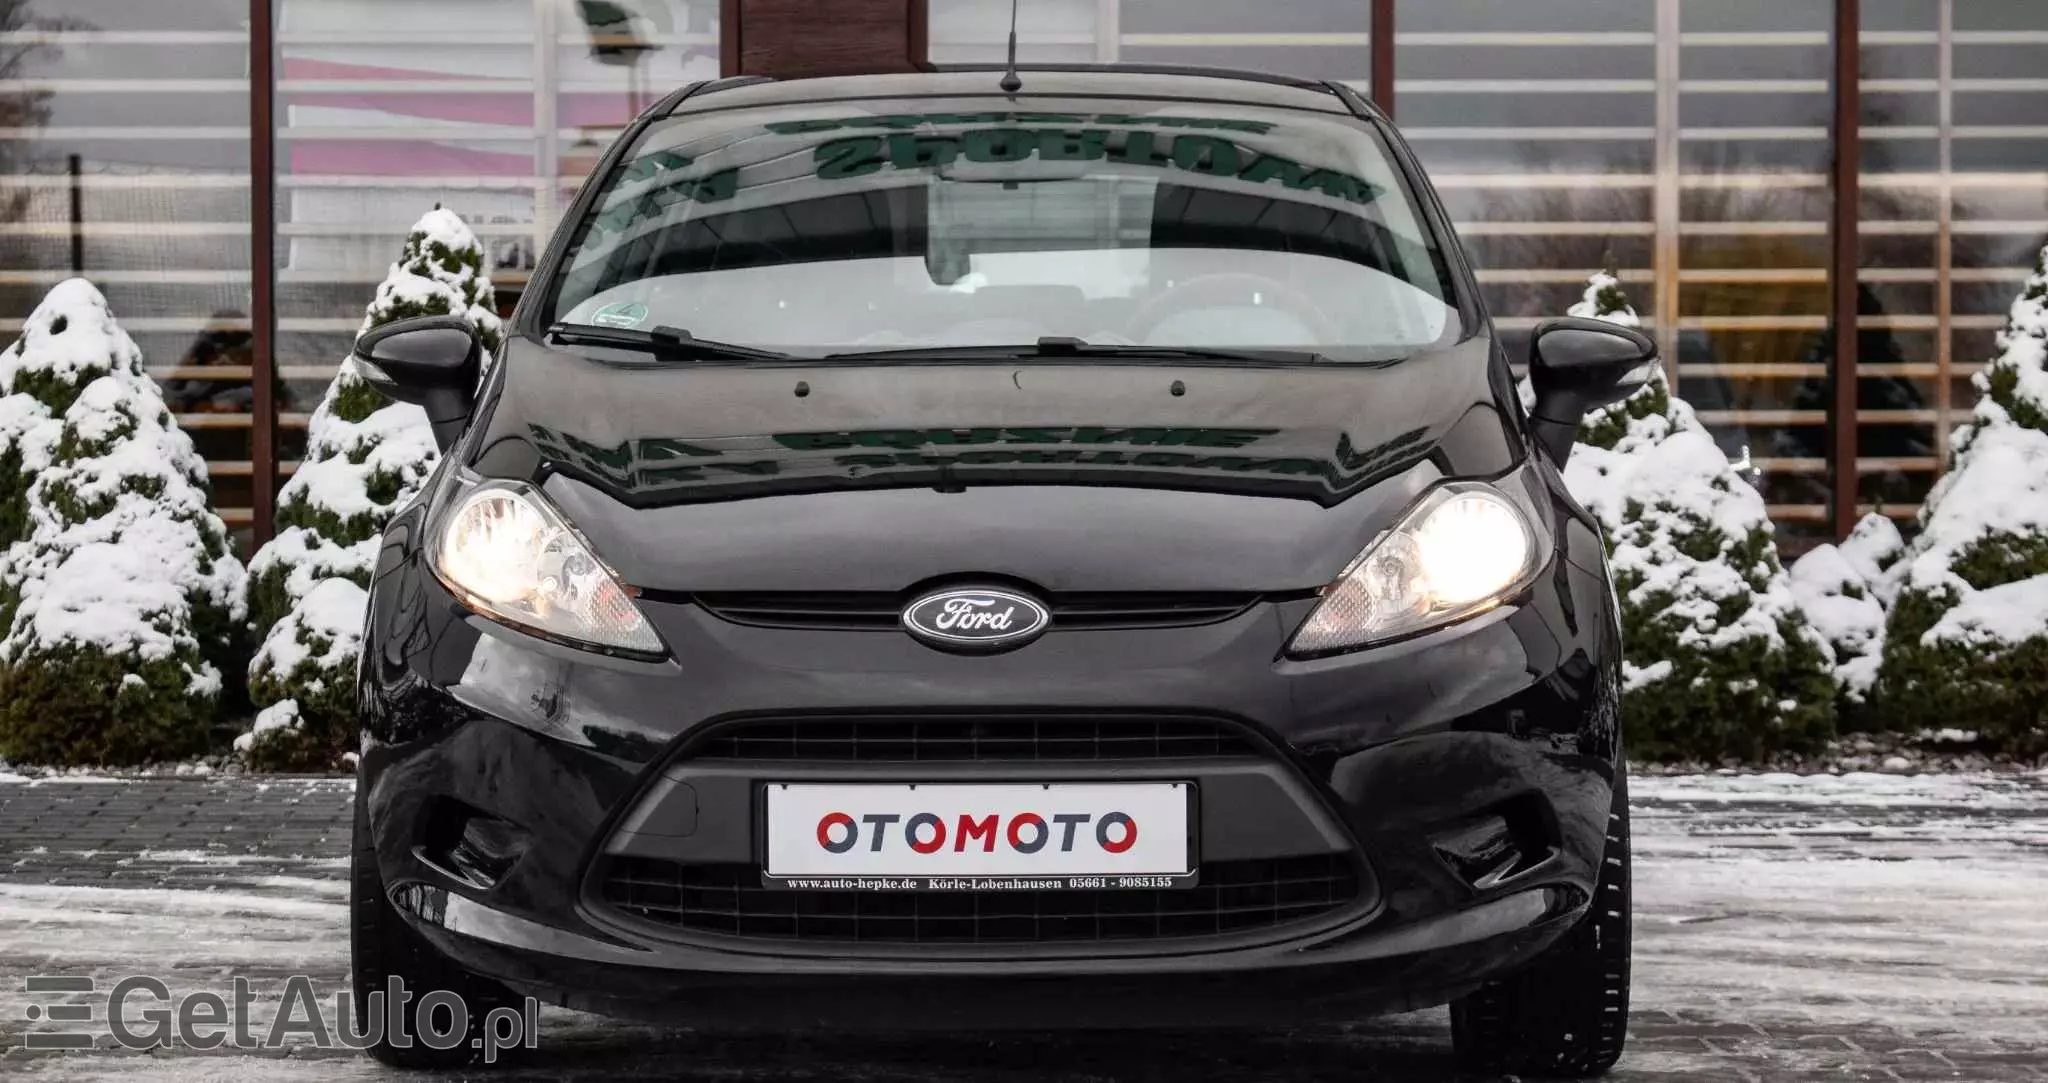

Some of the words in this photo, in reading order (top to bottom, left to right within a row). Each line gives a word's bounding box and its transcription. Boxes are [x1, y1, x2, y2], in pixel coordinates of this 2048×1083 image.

[936, 598, 1014, 629] Ford
[816, 812, 1138, 854] OTOMOTO
[787, 878, 917, 891] www.auto-hepke.de
[928, 878, 1062, 890] Körle-Lobenhausen
[1069, 877, 1106, 888] 05661
[1119, 876, 1173, 888] 9085155
